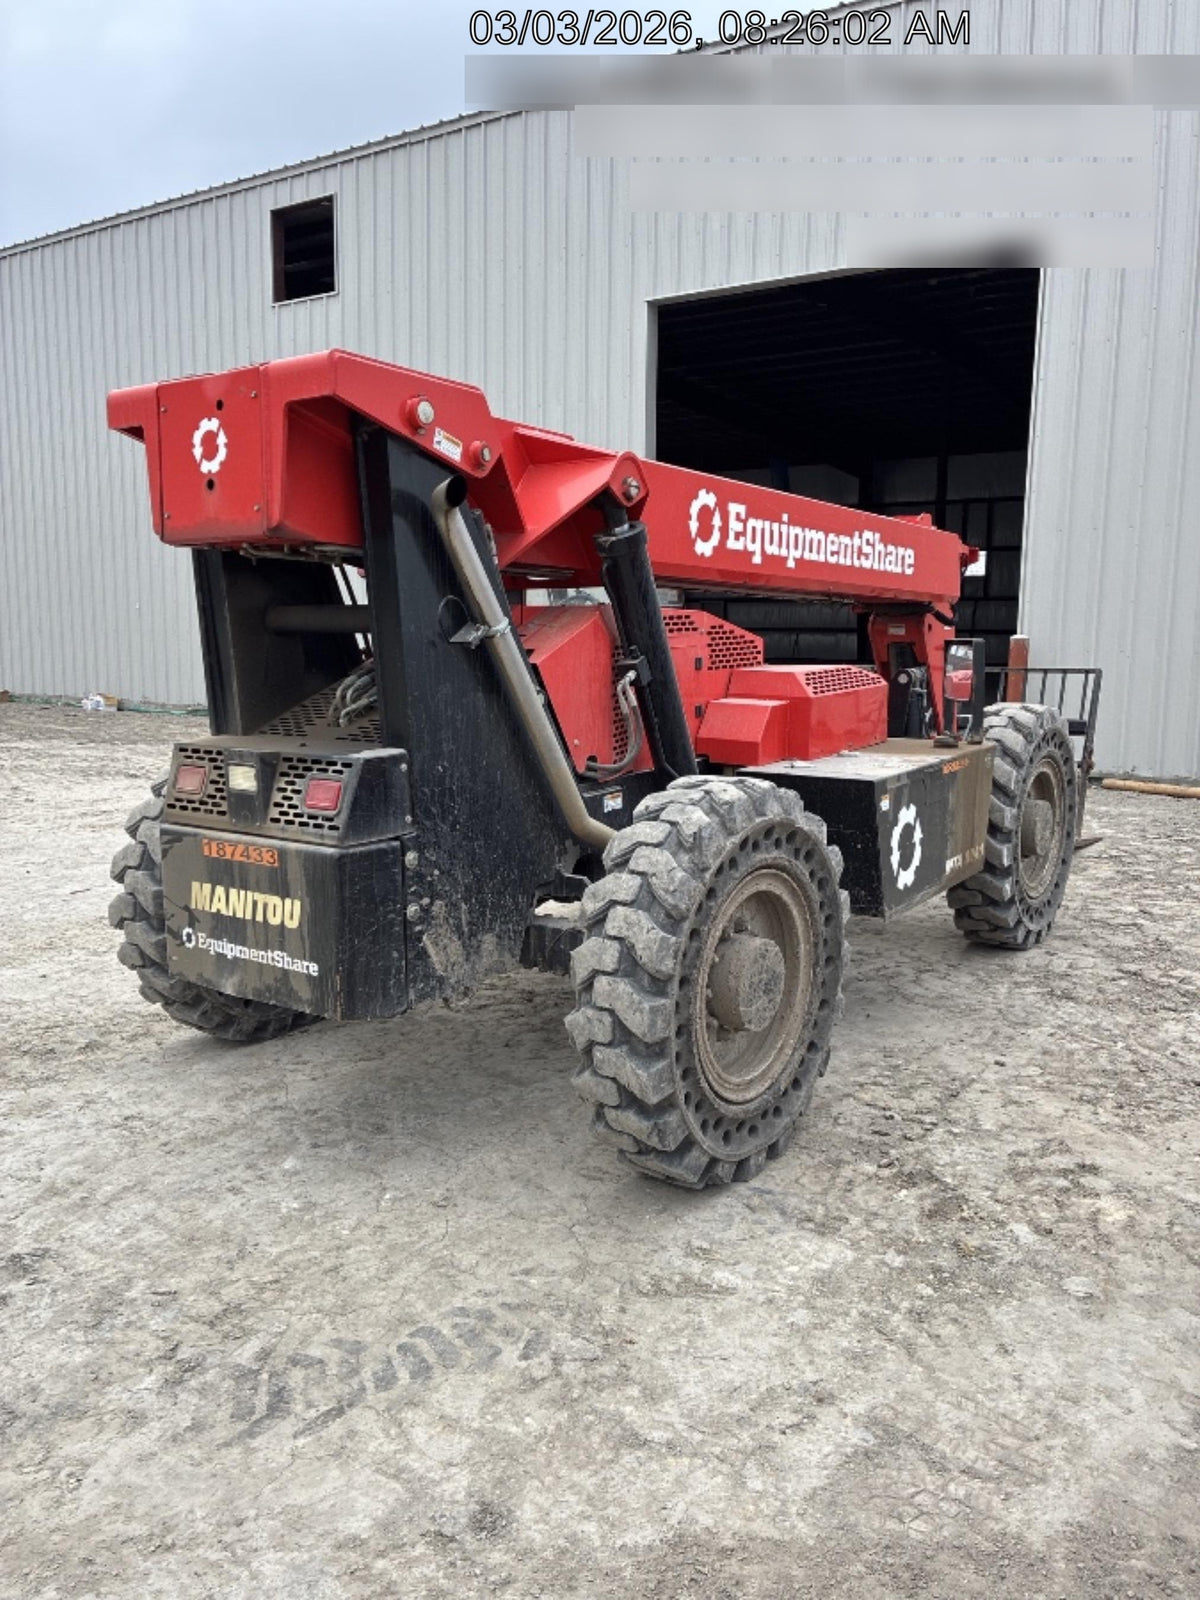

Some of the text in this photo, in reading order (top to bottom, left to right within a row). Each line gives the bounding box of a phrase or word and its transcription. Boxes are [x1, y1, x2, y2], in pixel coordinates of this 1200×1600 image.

[726, 501, 915, 576] EquipmentShare
[203, 841, 277, 865] 187433
[190, 881, 301, 929] MANITOU
[197, 932, 319, 977] EquipmentShare
